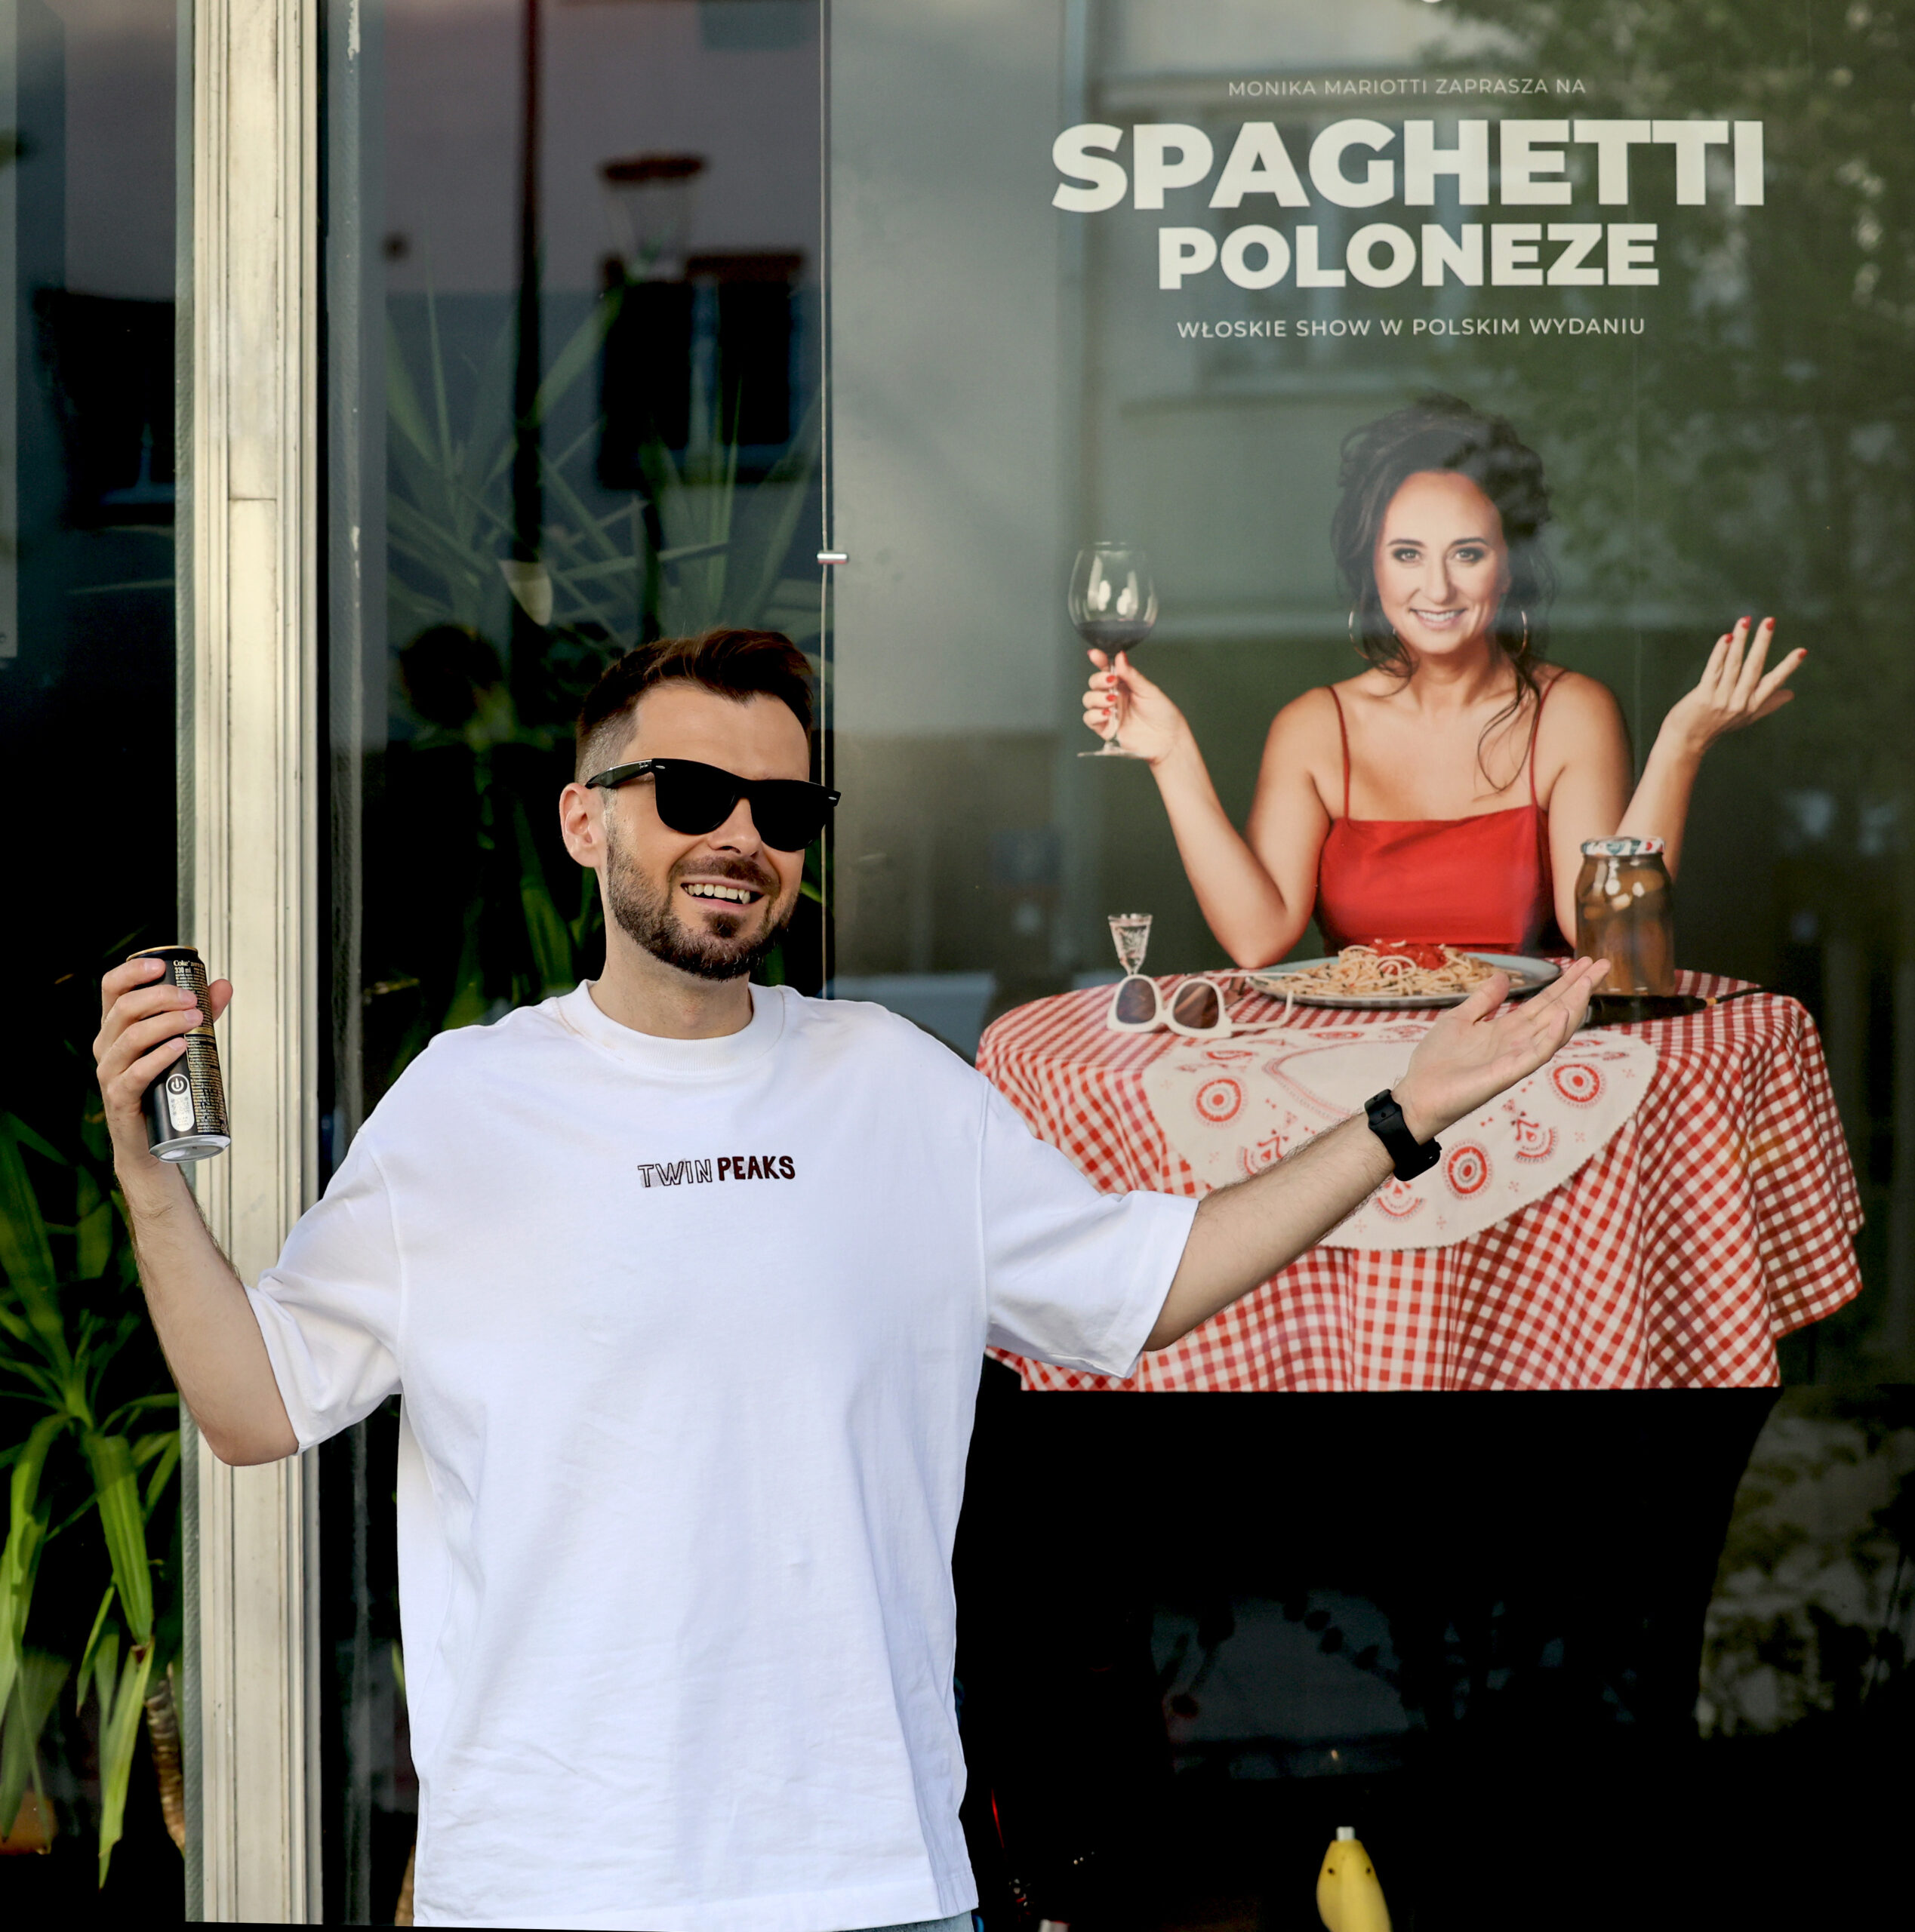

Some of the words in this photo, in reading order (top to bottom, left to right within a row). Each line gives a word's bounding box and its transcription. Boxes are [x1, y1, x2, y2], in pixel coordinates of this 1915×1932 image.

[1228, 81, 1316, 97] MONIKA
[1325, 79, 1427, 95] MARIOTTI
[1436, 78, 1548, 95] ZAPRASZA
[1556, 78, 1587, 94] NA
[1051, 118, 1765, 213] SPAGHETTI
[1159, 223, 1659, 290] POLONEZE
[1177, 319, 1287, 339] WŁOSKIE
[1296, 319, 1372, 337] SHOW
[1379, 319, 1403, 336] W
[1412, 318, 1520, 336] POLSKIM
[1529, 317, 1645, 335] WYDANIU
[638, 1159, 713, 1188] TWIN
[717, 1155, 796, 1181] PEAKS
